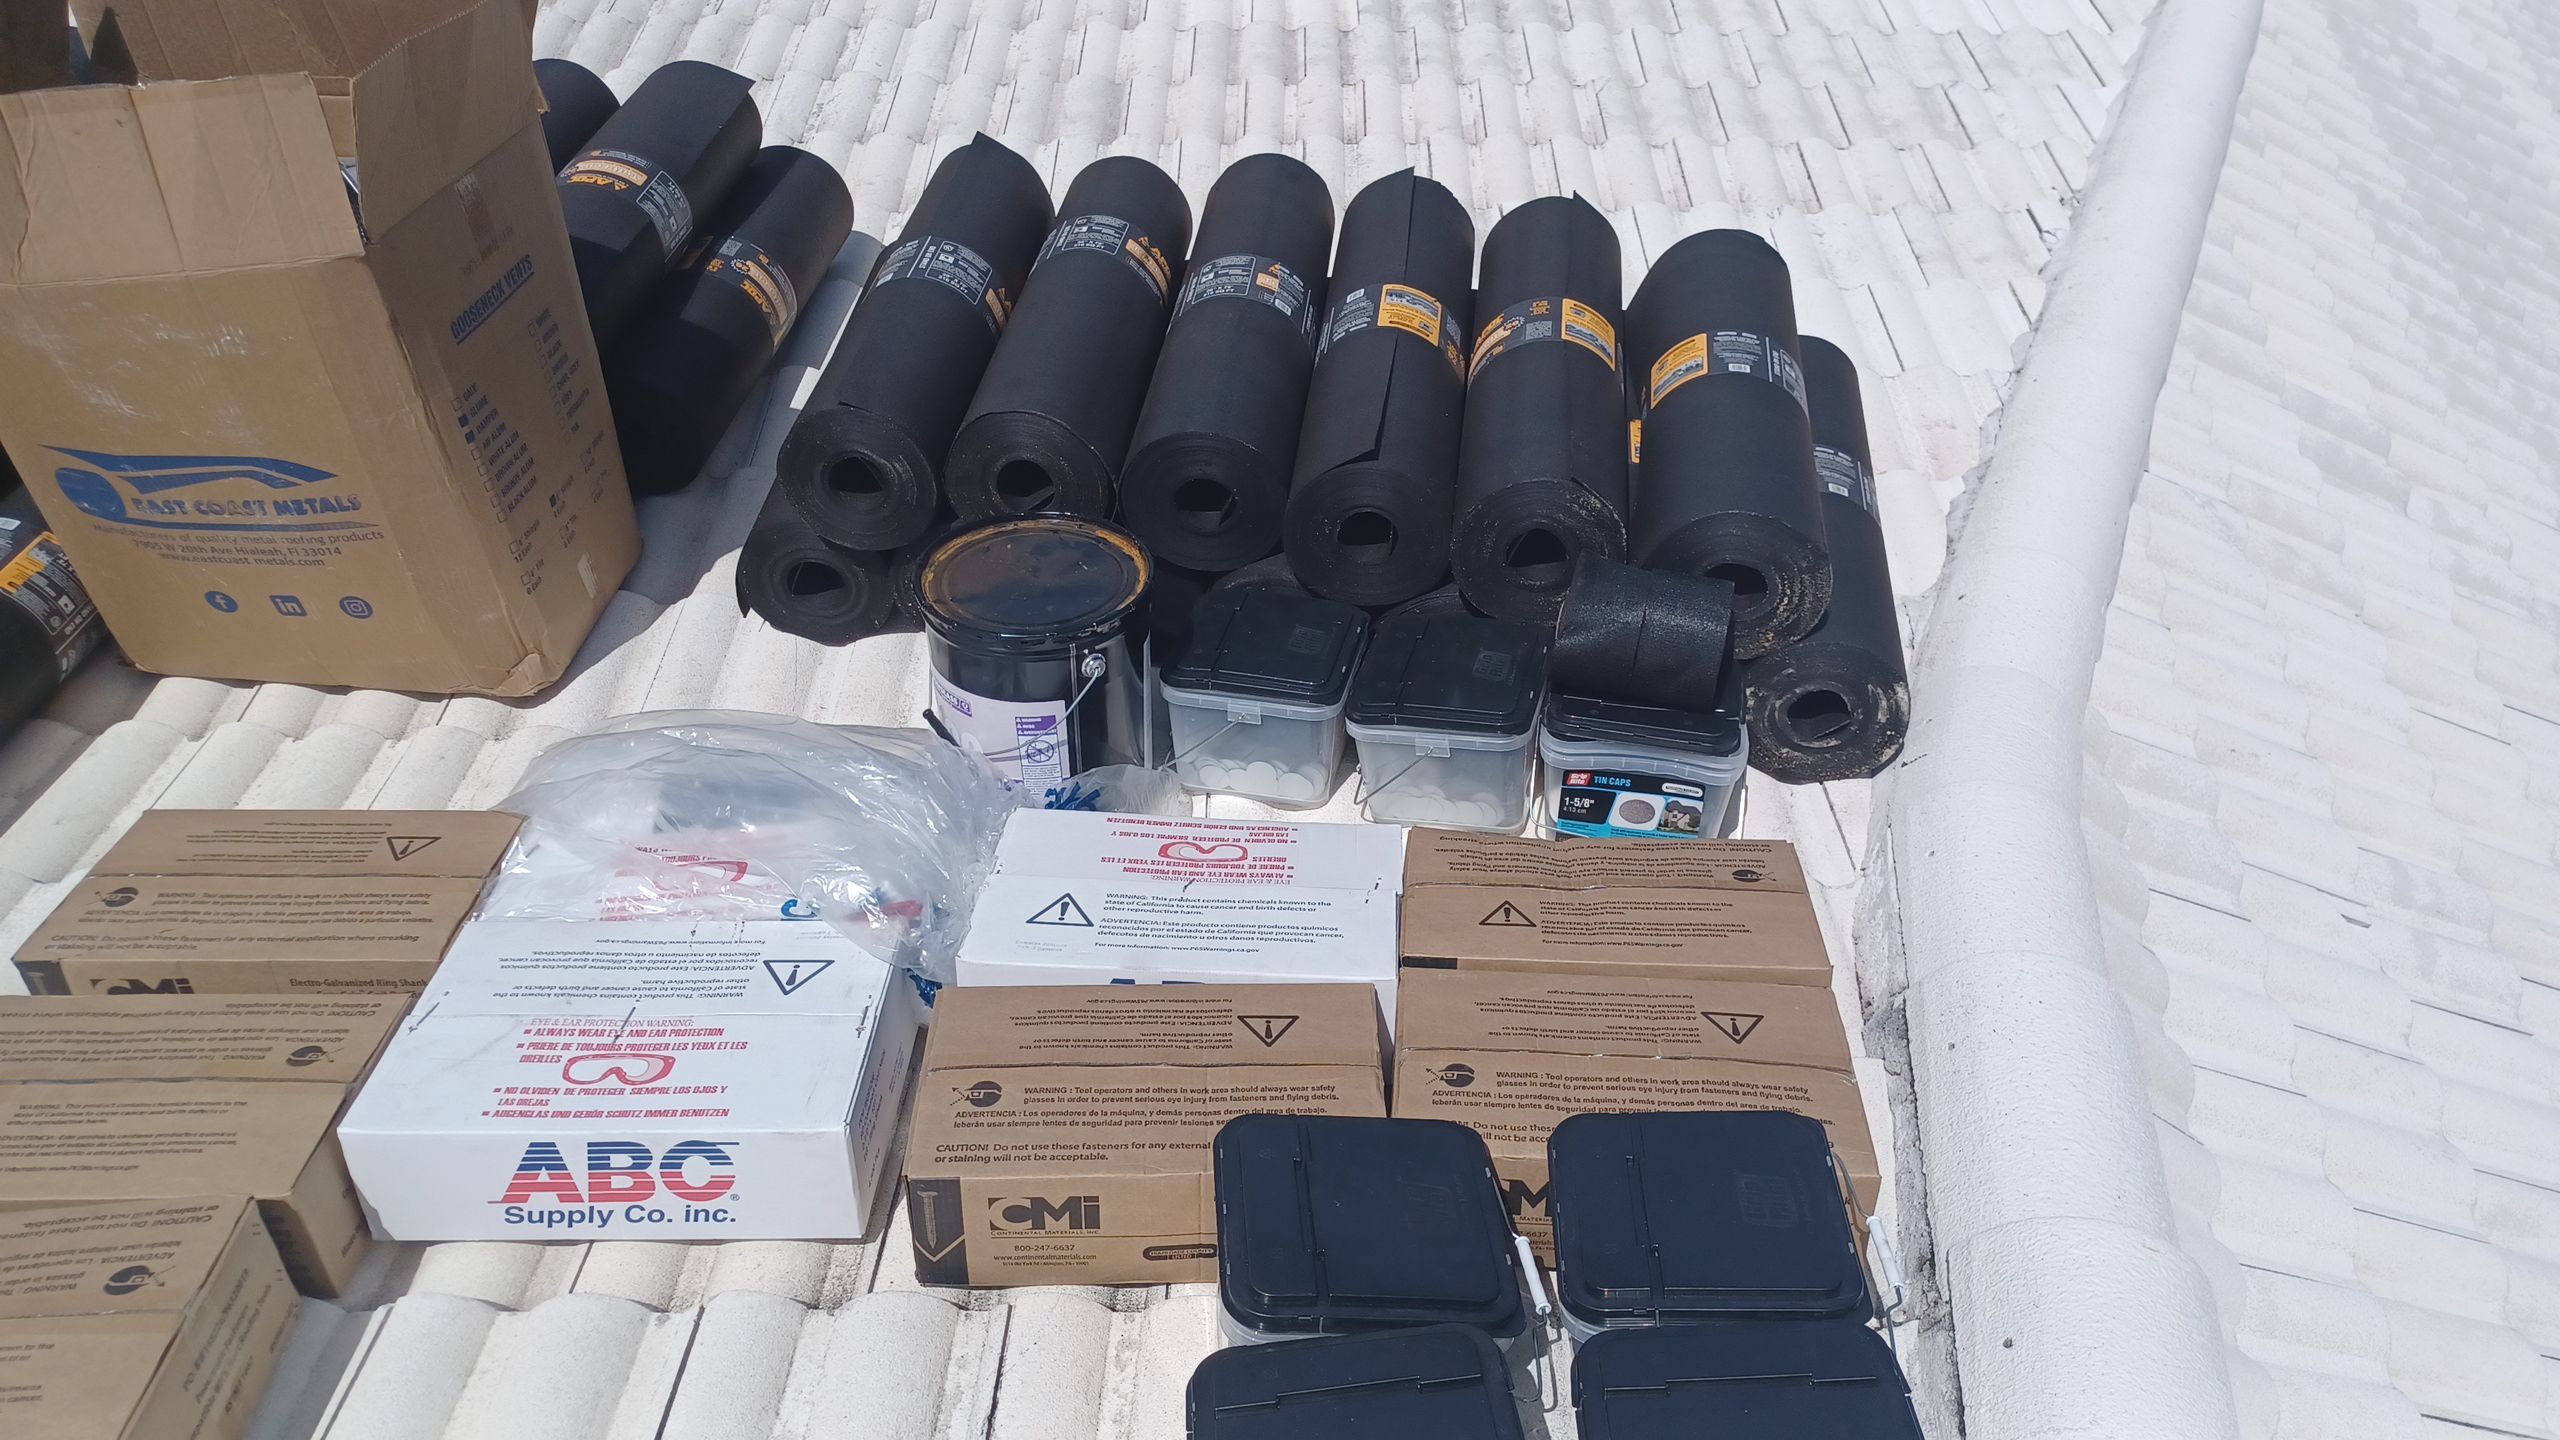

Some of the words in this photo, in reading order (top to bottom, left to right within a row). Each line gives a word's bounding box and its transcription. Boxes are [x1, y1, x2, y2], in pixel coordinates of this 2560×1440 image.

[451, 280, 505, 340] GOOSENECK
[503, 254, 533, 289] VENTS
[131, 498, 188, 515] EAST
[193, 499, 267, 516] COAST
[273, 494, 362, 516] METALS
[178, 533, 191, 541] of
[195, 534, 237, 545] quality
[240, 535, 278, 544] metal
[327, 530, 384, 543] products
[177, 544, 208, 553] 20th
[209, 545, 233, 554] Ave
[233, 546, 287, 557] Hialeah,
[300, 546, 341, 556] 33014
[1594, 775, 1608, 785] TIN
[1608, 777, 1632, 787] CAPS
[1106, 893, 1147, 901] WARNING:
[1151, 894, 1167, 902] This
[1168, 895, 1200, 903] product
[1237, 897, 1276, 905] chemicals
[1278, 898, 1305, 906] known
[289, 978, 374, 986] Electro-Galvanized
[375, 978, 398, 988] Ring
[530, 1018, 551, 1026] EYE
[561, 1018, 582, 1026] EAR
[646, 1018, 694, 1027] WARNING:
[533, 1027, 576, 1036] ALWAYS
[577, 1028, 606, 1037] WEAR
[625, 1029, 647, 1037] AND
[647, 1028, 667, 1037] EAR
[668, 1027, 724, 1037] PROTECTION
[526, 1041, 559, 1050] PRIERE
[559, 1042, 574, 1050] DE
[623, 1042, 670, 1051] PROTEGER
[671, 1042, 689, 1050] LES
[690, 1041, 716, 1050] YEUX
[716, 1041, 729, 1050] ET
[728, 1041, 748, 1049] LES
[503, 1086, 518, 1094] NO
[519, 1086, 560, 1095] OLVIDEN
[563, 1087, 576, 1095] DE
[577, 1087, 626, 1095] PROTEGER
[629, 1086, 671, 1095] SIEMPRE
[672, 1085, 691, 1094] LOS
[720, 1085, 728, 1093] Y
[1024, 1086, 1067, 1094] WARNING
[1074, 1086, 1092, 1094] Tool
[1093, 1087, 1132, 1095] operators
[1134, 1086, 1150, 1094] and
[1151, 1086, 1178, 1094] others
[1179, 1086, 1187, 1094] in
[1189, 1087, 1209, 1095] work
[1210, 1086, 1228, 1094] area
[1230, 1085, 1258, 1093] should
[1260, 1085, 1287, 1093] always
[1310, 1084, 1335, 1092] safety
[1023, 1097, 1055, 1105] glasses
[1057, 1095, 1065, 1103] in
[1066, 1095, 1088, 1103] order
[1091, 1095, 1099, 1103] to
[1101, 1096, 1132, 1104] prevent
[1134, 1095, 1165, 1103] serious
[1166, 1096, 1181, 1104] eye
[1183, 1095, 1206, 1104] injury
[1208, 1095, 1227, 1103] from
[1229, 1094, 1267, 1102] fasteners
[1268, 1094, 1284, 1102] and
[1286, 1093, 1309, 1102] flying
[1310, 1093, 1339, 1101] debris.
[954, 1110, 1016, 1118] ADVERTENCIA
[1023, 1109, 1038, 1117] Los
[1040, 1109, 1086, 1117] operadores
[1088, 1109, 1098, 1117] de
[1100, 1109, 1108, 1117] la
[1148, 1110, 1154, 1118] y
[1184, 1109, 1221, 1117] personas
[1223, 1108, 1250, 1116] dentro
[1251, 1107, 1265, 1115] del
[1285, 1107, 1295, 1115] de
[1473, 1121, 1488, 1129] Do
[1490, 1123, 1508, 1131] not
[1509, 1124, 1527, 1132] use
[935, 1143, 988, 1152] CAUTION!
[993, 1143, 1008, 1151] Do
[1010, 1143, 1028, 1151] not
[1031, 1143, 1049, 1151] use
[1051, 1142, 1079, 1150] these
[1081, 1142, 1128, 1150] fasteners
[1131, 1141, 1146, 1149] for
[1147, 1142, 1166, 1150] any
[1168, 1142, 1210, 1150] external
[934, 1155, 946, 1163] or
[948, 1154, 990, 1163] staining
[992, 1153, 1011, 1161] will
[1013, 1154, 1031, 1162] not
[1033, 1152, 1047, 1160] be
[1049, 1152, 1108, 1160] acceptable.
[488, 1140, 740, 1204] ABC
[504, 1205, 614, 1228] Supply
[624, 1204, 673, 1223] Co.
[684, 1204, 736, 1223] inc.
[1014, 1244, 1075, 1252] 800-247-6637
[993, 1253, 1096, 1261] www.continentalmaterials.com
